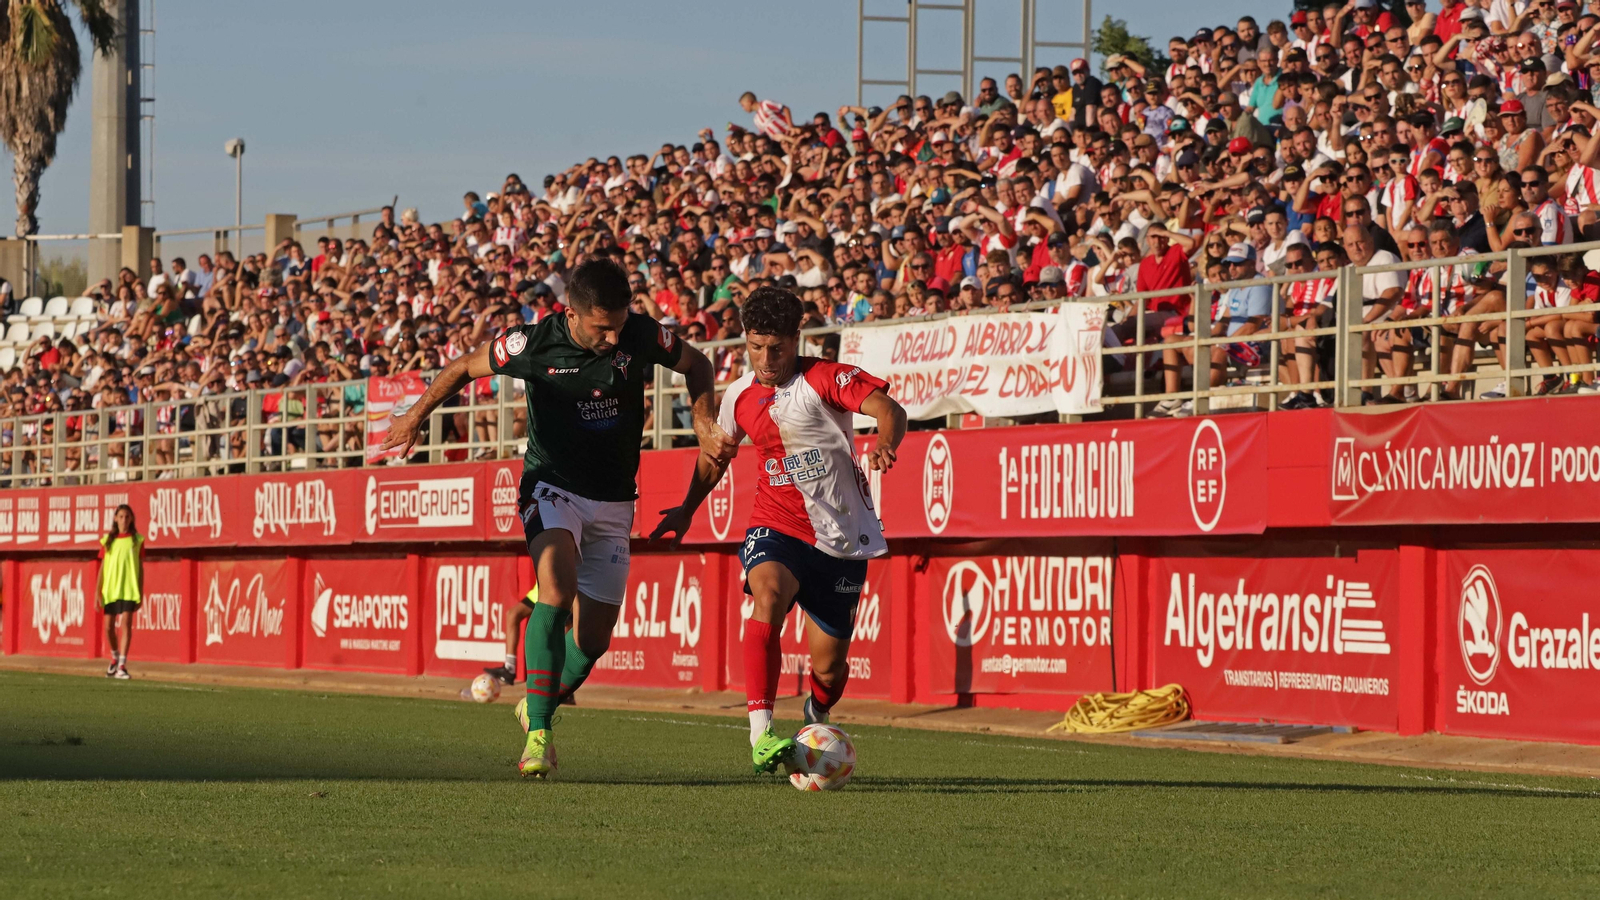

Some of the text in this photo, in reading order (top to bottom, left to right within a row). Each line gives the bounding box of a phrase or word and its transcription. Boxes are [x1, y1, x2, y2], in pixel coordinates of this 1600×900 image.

[555, 367, 580, 375] LOTTO
[576, 397, 619, 411] Estrella
[580, 407, 619, 421] Galicia
[783, 448, 823, 472] 威视
[1021, 428, 1134, 519] FEDERACIÓN
[379, 488, 470, 519] EUROGRUAS
[492, 487, 517, 505] COSCO
[992, 556, 1112, 611] HYUNDAI
[991, 616, 1111, 646] PERMOTOR
[1164, 572, 1346, 668] Algetransit
[1224, 670, 1389, 696] TRANSITARIOS REPRESENTANTES ADUANEROS
[1456, 685, 1510, 715] ŠKODA
